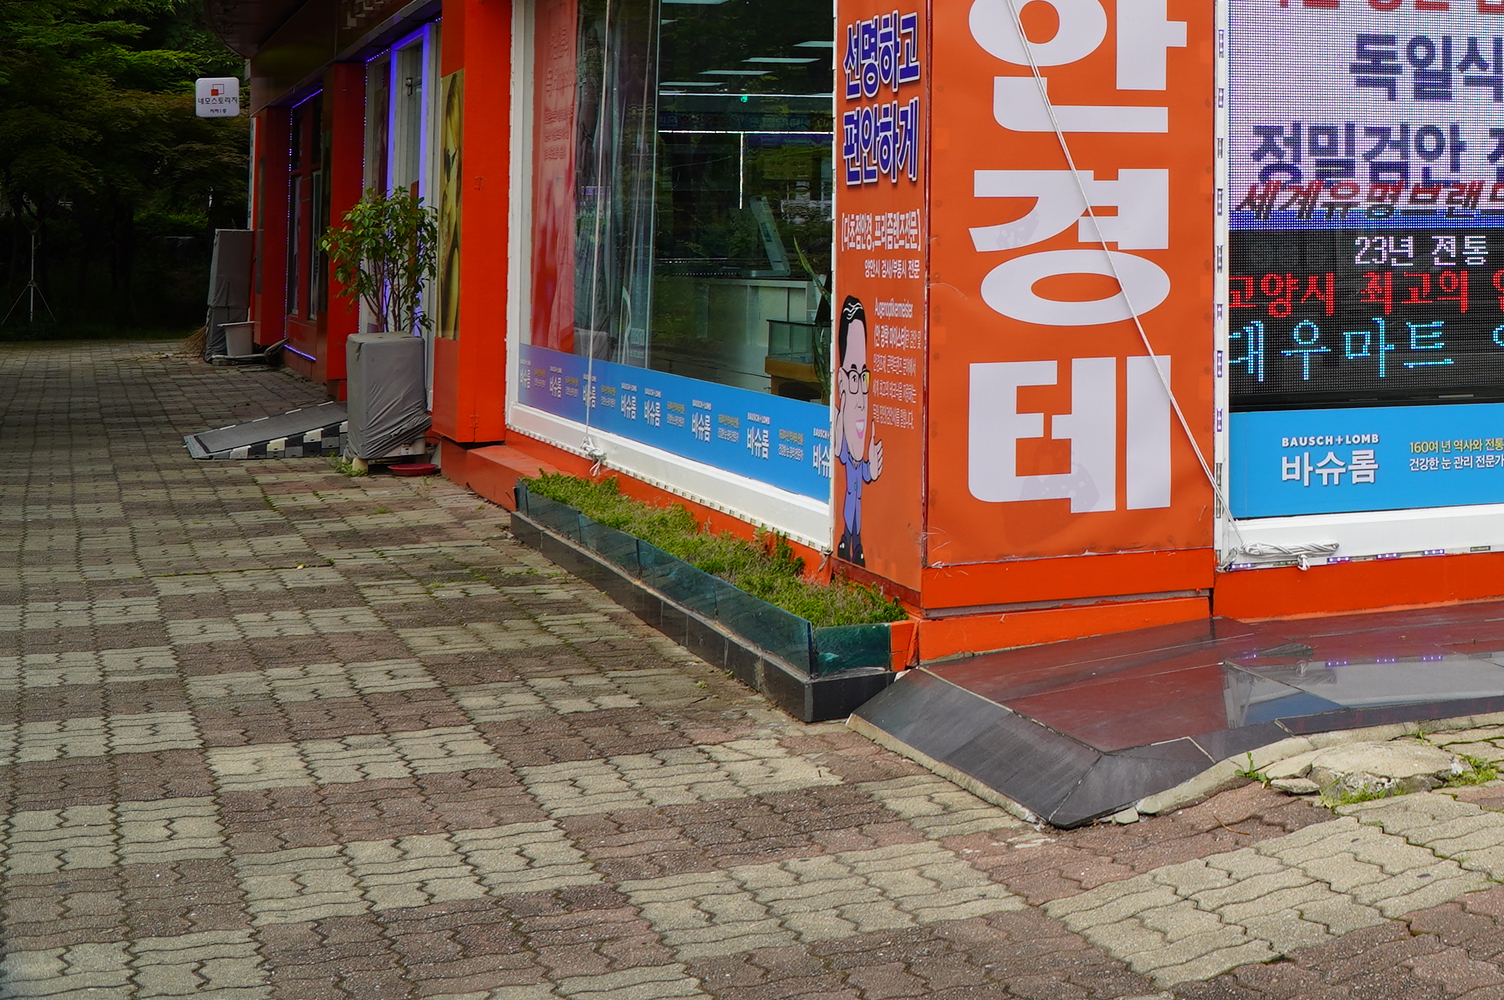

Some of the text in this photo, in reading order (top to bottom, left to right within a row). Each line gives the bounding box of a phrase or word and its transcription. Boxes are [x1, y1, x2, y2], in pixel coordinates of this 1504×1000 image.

[843, 10, 920, 100] 선명하고
[843, 96, 919, 185] 편안하게
[1252, 122, 1466, 189] 정밀검안
[1355, 235, 1489, 266] 23년 전통
[907, 259, 921, 279] 전문
[1229, 272, 1334, 318] 고양시
[1360, 271, 1469, 314] 최고의
[1229, 317, 1454, 383] 대우마트
[692, 412, 711, 442] 바슈롬
[746, 426, 769, 460] 바슈롬
[1409, 437, 1504, 454] 160여 년 역사와 전통
[1409, 454, 1504, 472] 건강한 눈 관리 전문가
[1281, 449, 1379, 486] 바슈롬
